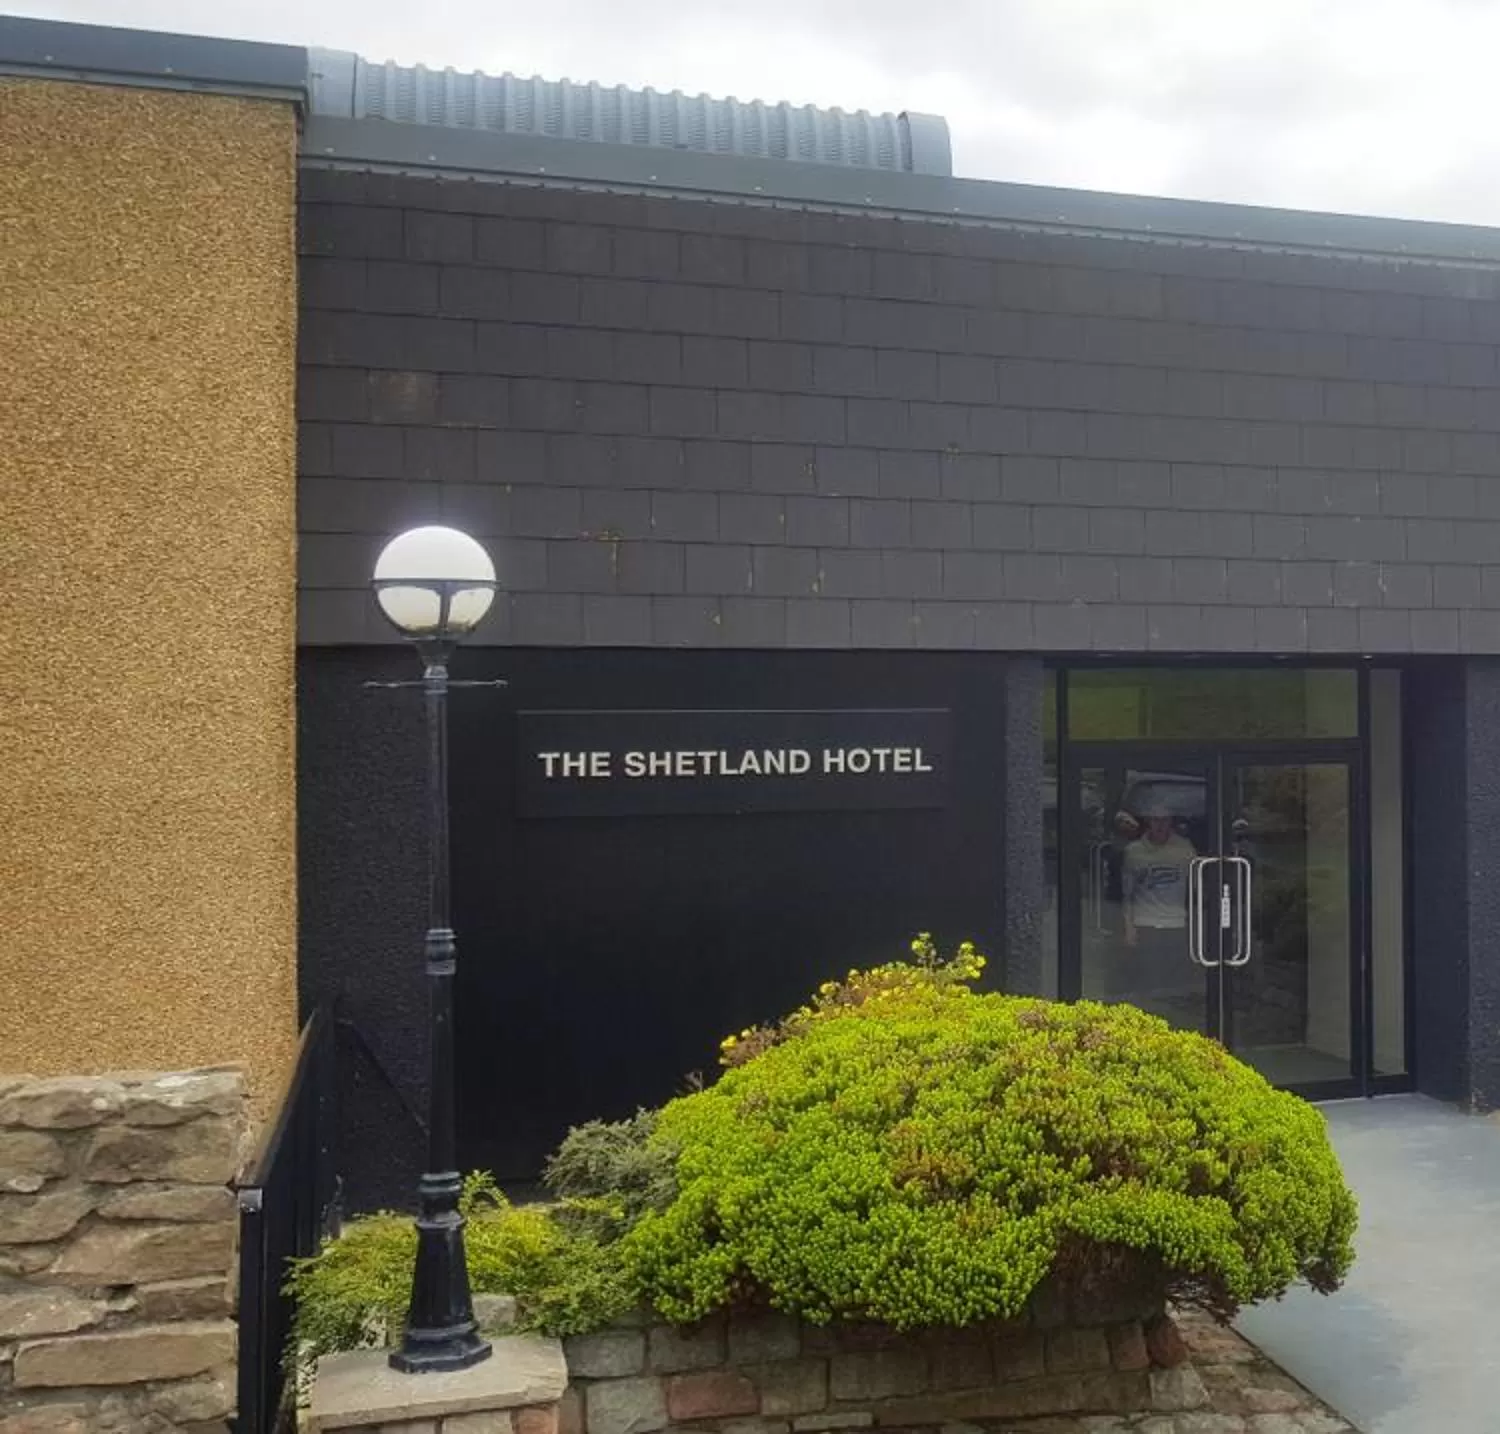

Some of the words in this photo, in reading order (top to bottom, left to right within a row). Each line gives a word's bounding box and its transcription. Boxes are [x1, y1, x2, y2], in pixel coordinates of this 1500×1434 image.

[537, 751, 611, 777] THE
[624, 749, 811, 777] SHETLAND
[823, 747, 933, 773] HOTEL
